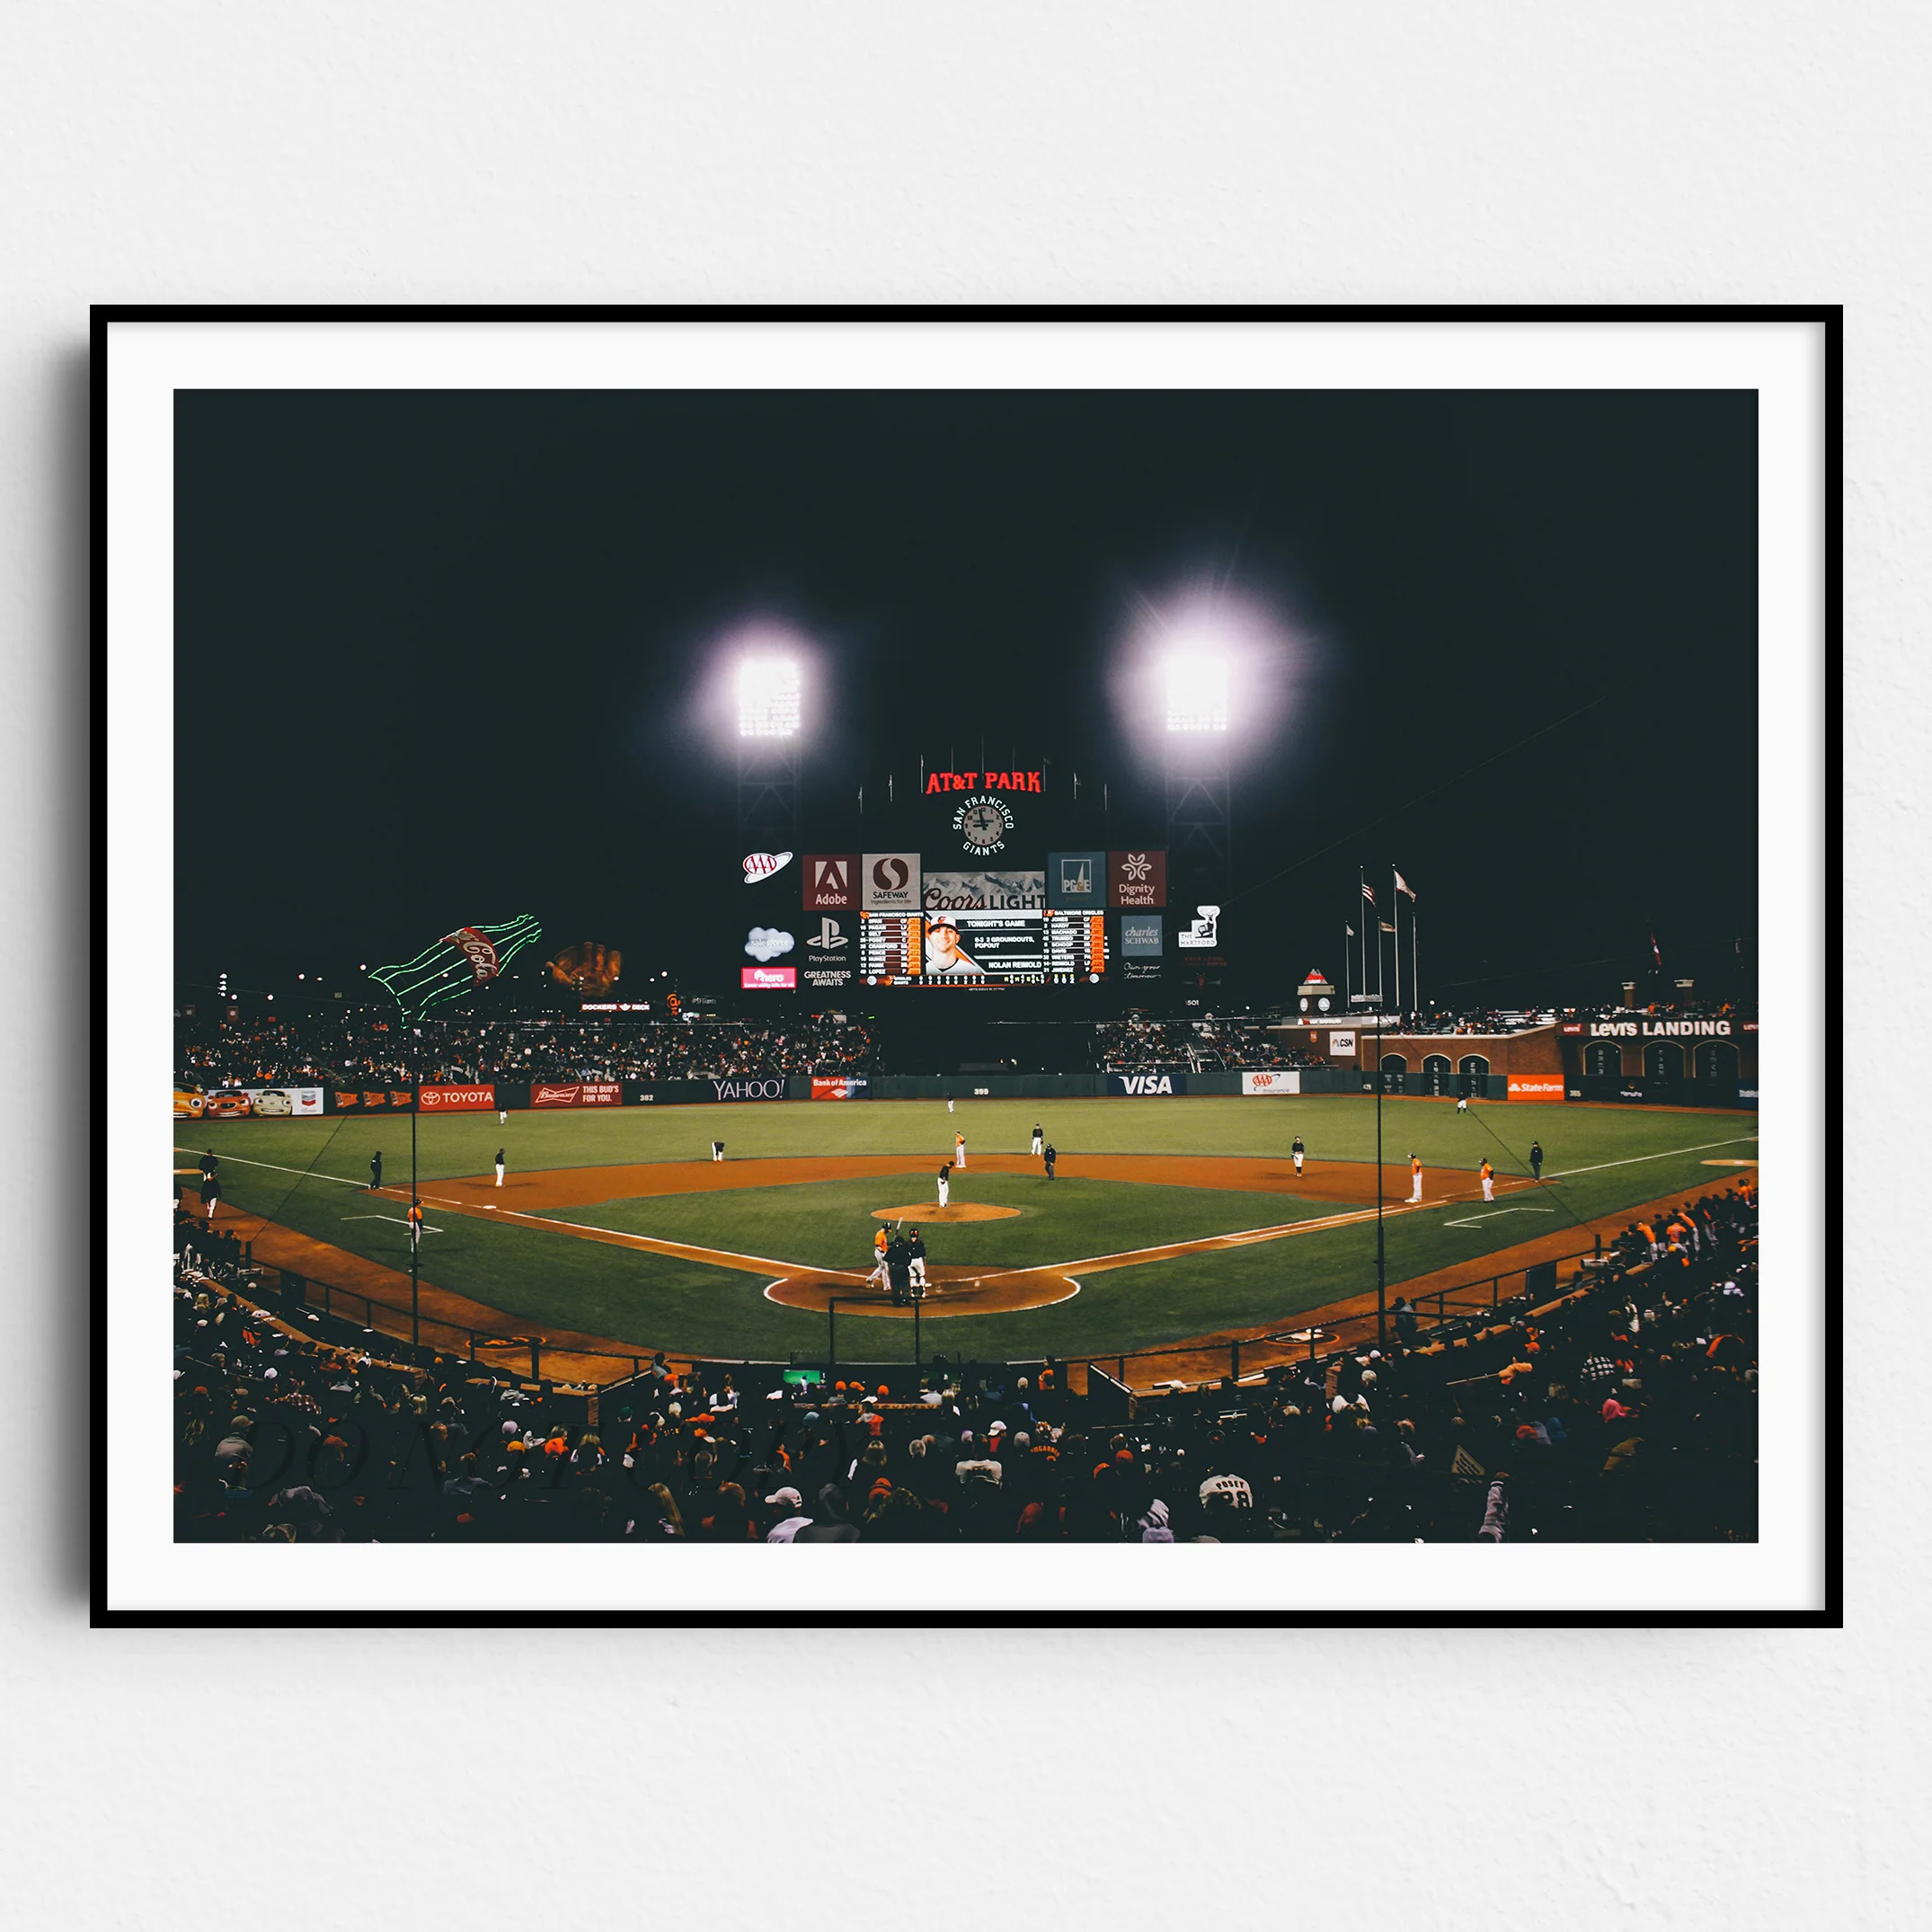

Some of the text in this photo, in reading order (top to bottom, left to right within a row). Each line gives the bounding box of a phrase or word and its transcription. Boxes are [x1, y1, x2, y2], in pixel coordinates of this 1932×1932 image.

[926, 771, 1041, 794] AT&T PARK
[953, 795, 1015, 830] SAN FRANCISCO
[962, 840, 1006, 856] GIANTS
[747, 855, 777, 874] AAA
[1063, 878, 1091, 892] PG&E
[1119, 883, 1156, 897] Dignity
[815, 894, 847, 905] Adobe
[873, 891, 908, 900] SAFEWAY
[925, 887, 1045, 910] Coors LIGHT
[1121, 895, 1155, 905] Health
[1124, 926, 1158, 937] charles
[750, 938, 789, 948] salesforce
[808, 955, 846, 963] PlayStation
[762, 972, 784, 983] hero
[803, 970, 852, 979] GREATNESS
[812, 979, 844, 987] AWAITS
[1642, 1021, 1731, 1035] LANDING
[1340, 1039, 1354, 1047] CSN
[1119, 1076, 1173, 1095] VISA
[1252, 1074, 1272, 1087] AAA
[713, 1080, 785, 1100] YAHOO!
[442, 1092, 494, 1103] TOYOTA
[1216, 1480, 1245, 1490] POSEY
